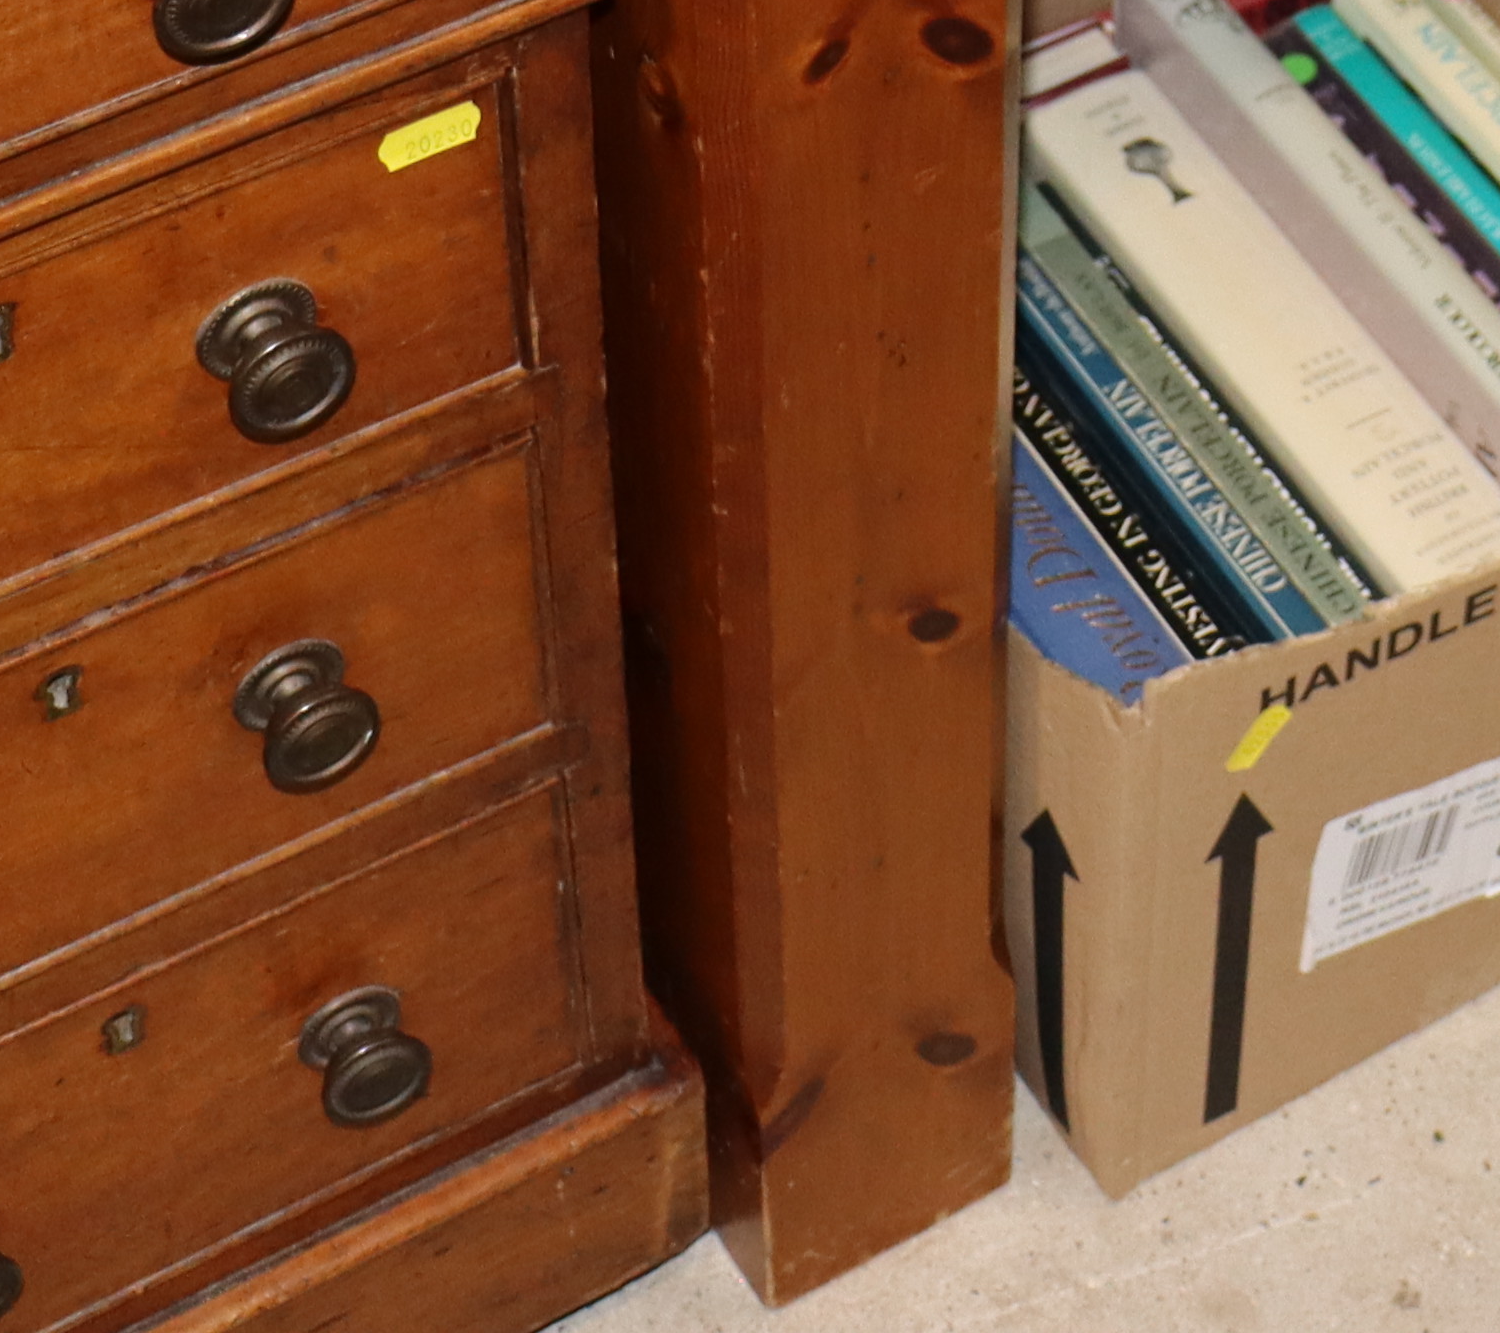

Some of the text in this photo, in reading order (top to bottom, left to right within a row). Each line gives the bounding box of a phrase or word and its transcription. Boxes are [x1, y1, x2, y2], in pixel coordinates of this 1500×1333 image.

[405, 117, 474, 161] 20230
[1021, 386, 1125, 518] GEORGIAN
[1101, 377, 1210, 508] PORCELAIN
[1153, 369, 1274, 512] PORCELAIN
[1111, 509, 1141, 551] IN
[1199, 495, 1288, 595] CHINESE
[1272, 509, 1358, 619] CHINESE
[1258, 583, 1499, 715] HANDLE
